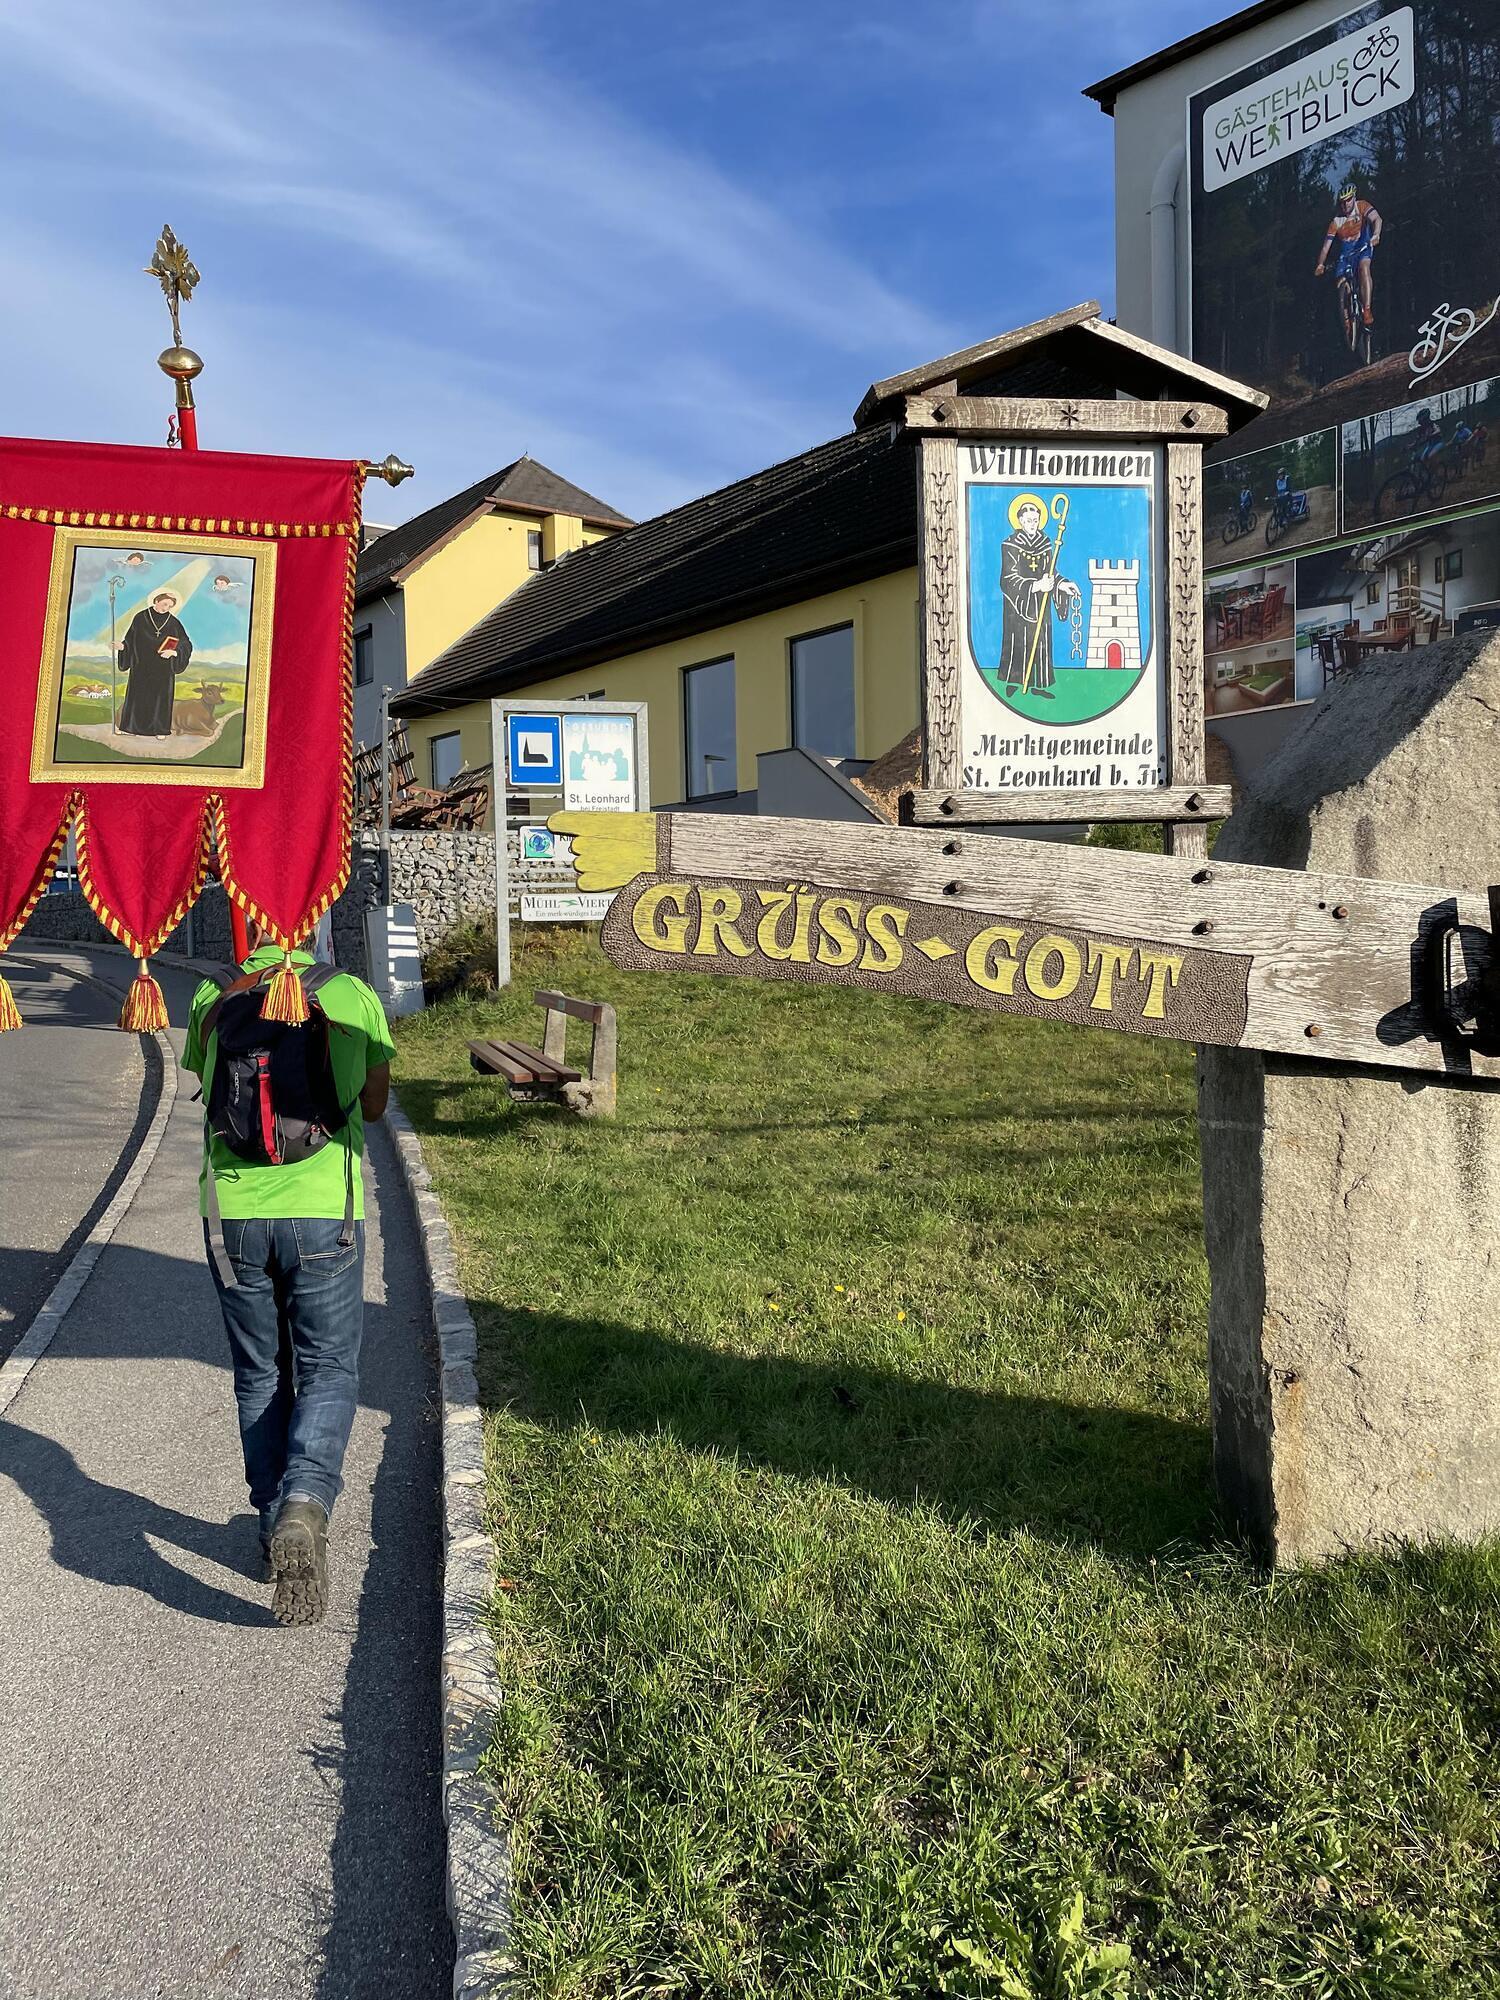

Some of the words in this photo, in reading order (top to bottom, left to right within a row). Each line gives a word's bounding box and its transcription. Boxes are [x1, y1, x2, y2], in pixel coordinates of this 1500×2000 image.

[1215, 57, 1349, 140] GÄSTEHAUS
[967, 444, 1153, 479] Willkommen
[973, 733, 1153, 760] Marktgemeinde
[962, 765, 990, 788] St.
[998, 763, 1102, 787] Leonhard
[1110, 764, 1129, 787] b.
[569, 793, 582, 803] St.
[585, 793, 630, 804] Leonhard
[524, 896, 560, 909] MÜHL
[577, 896, 612, 908] VIERT
[632, 882, 911, 974] GRÜSS
[963, 925, 1185, 1020] GOTT
